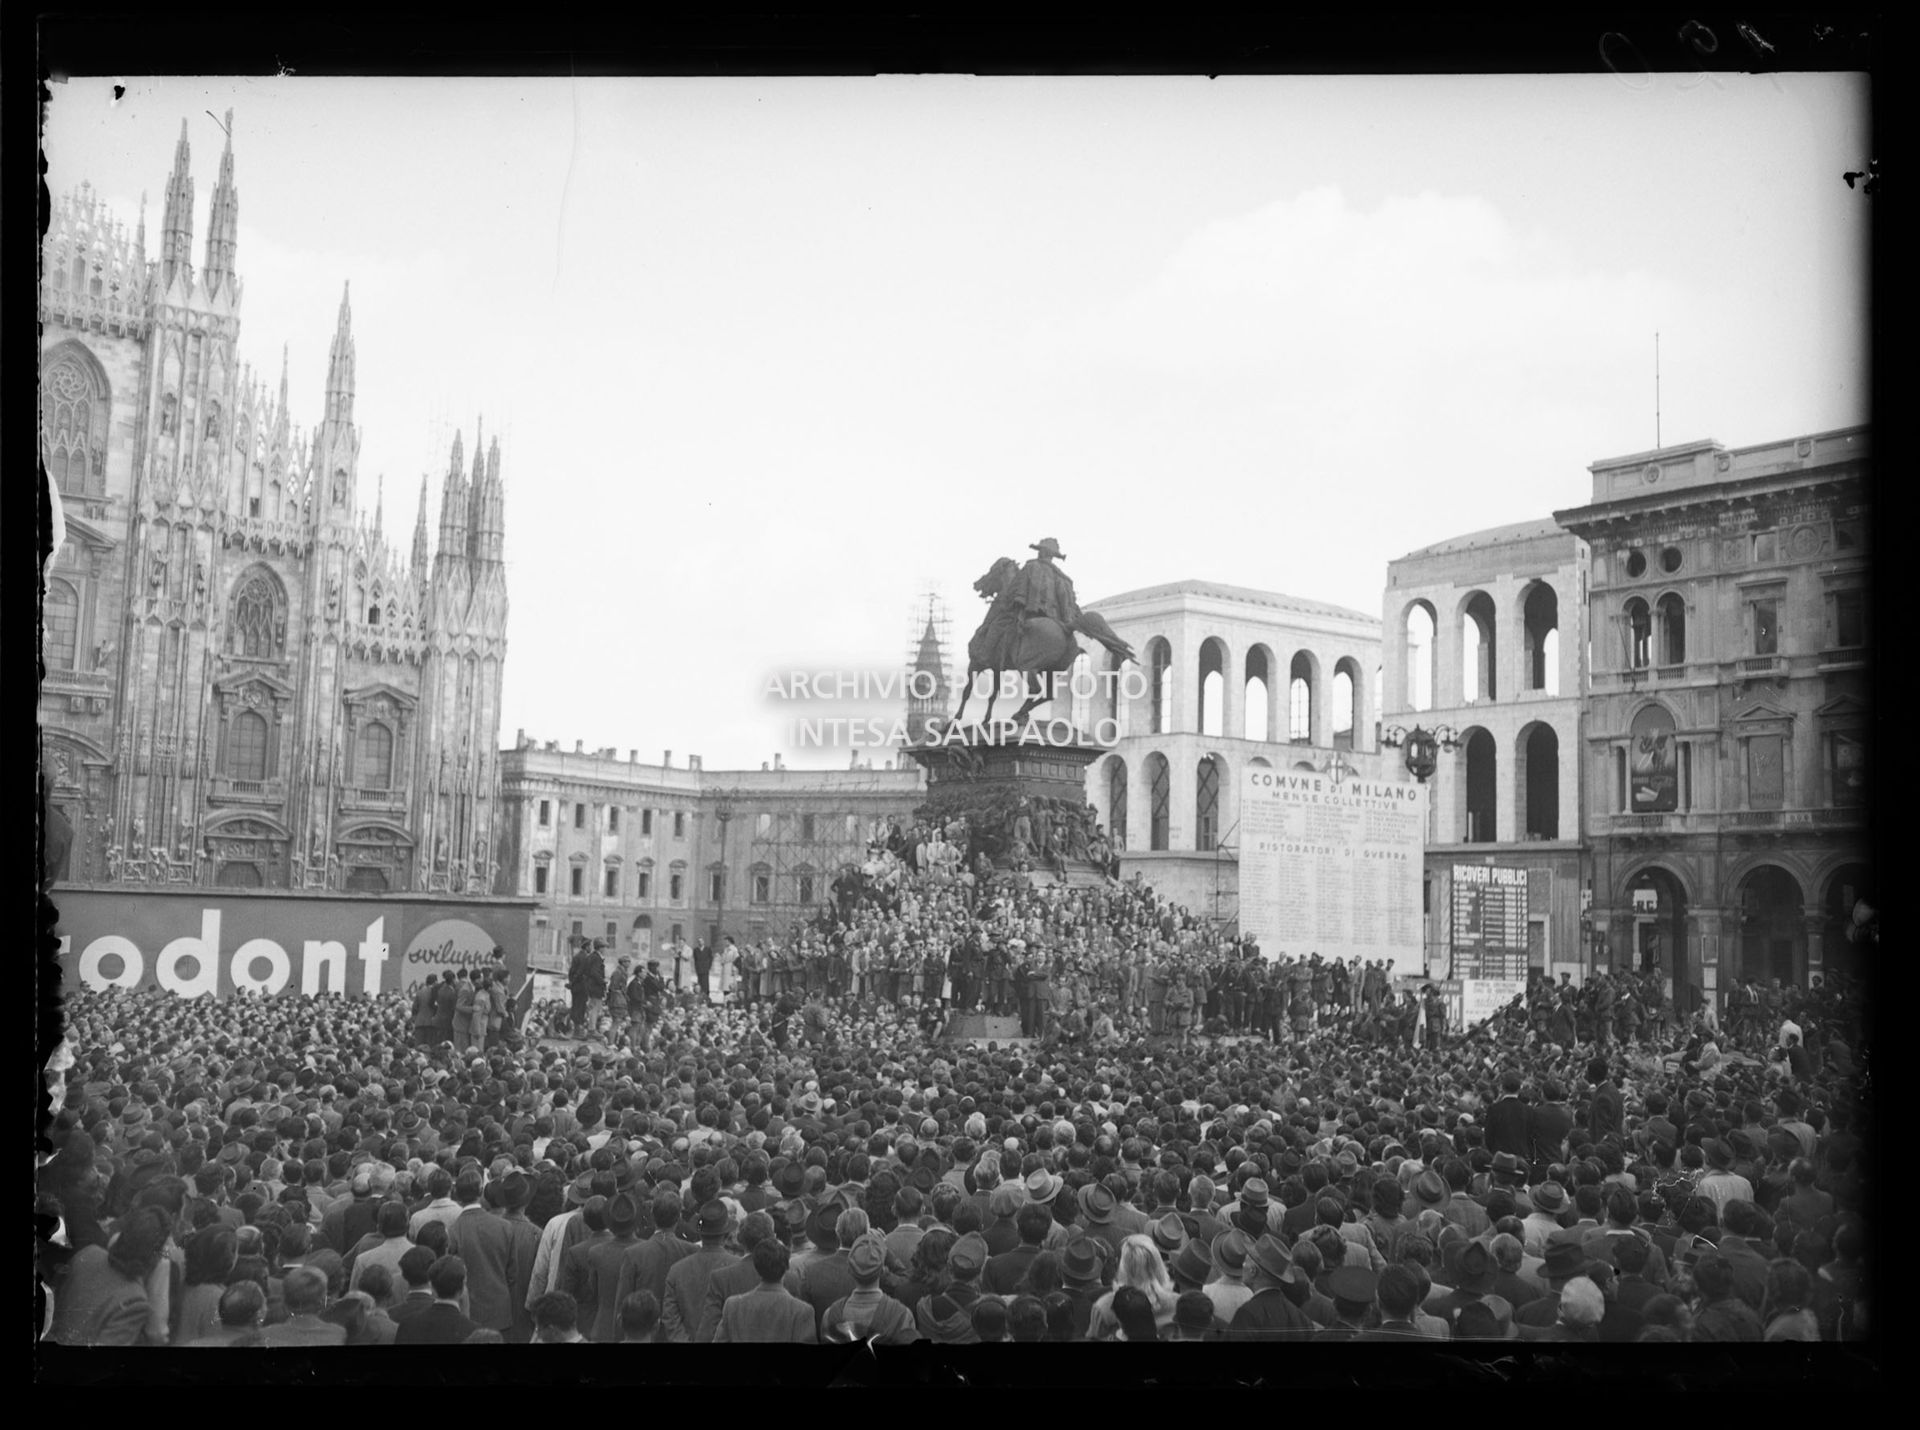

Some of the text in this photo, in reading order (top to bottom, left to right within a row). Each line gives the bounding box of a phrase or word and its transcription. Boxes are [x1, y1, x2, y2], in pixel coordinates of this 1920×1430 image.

[1352, 783, 1417, 801] MILANO
[1324, 796, 1398, 811] COLLETTIVE
[1259, 841, 1336, 855] RISTORATORI
[1453, 864, 1527, 886] RICOVERI PUBBLICI
[58, 908, 389, 1000] odont
